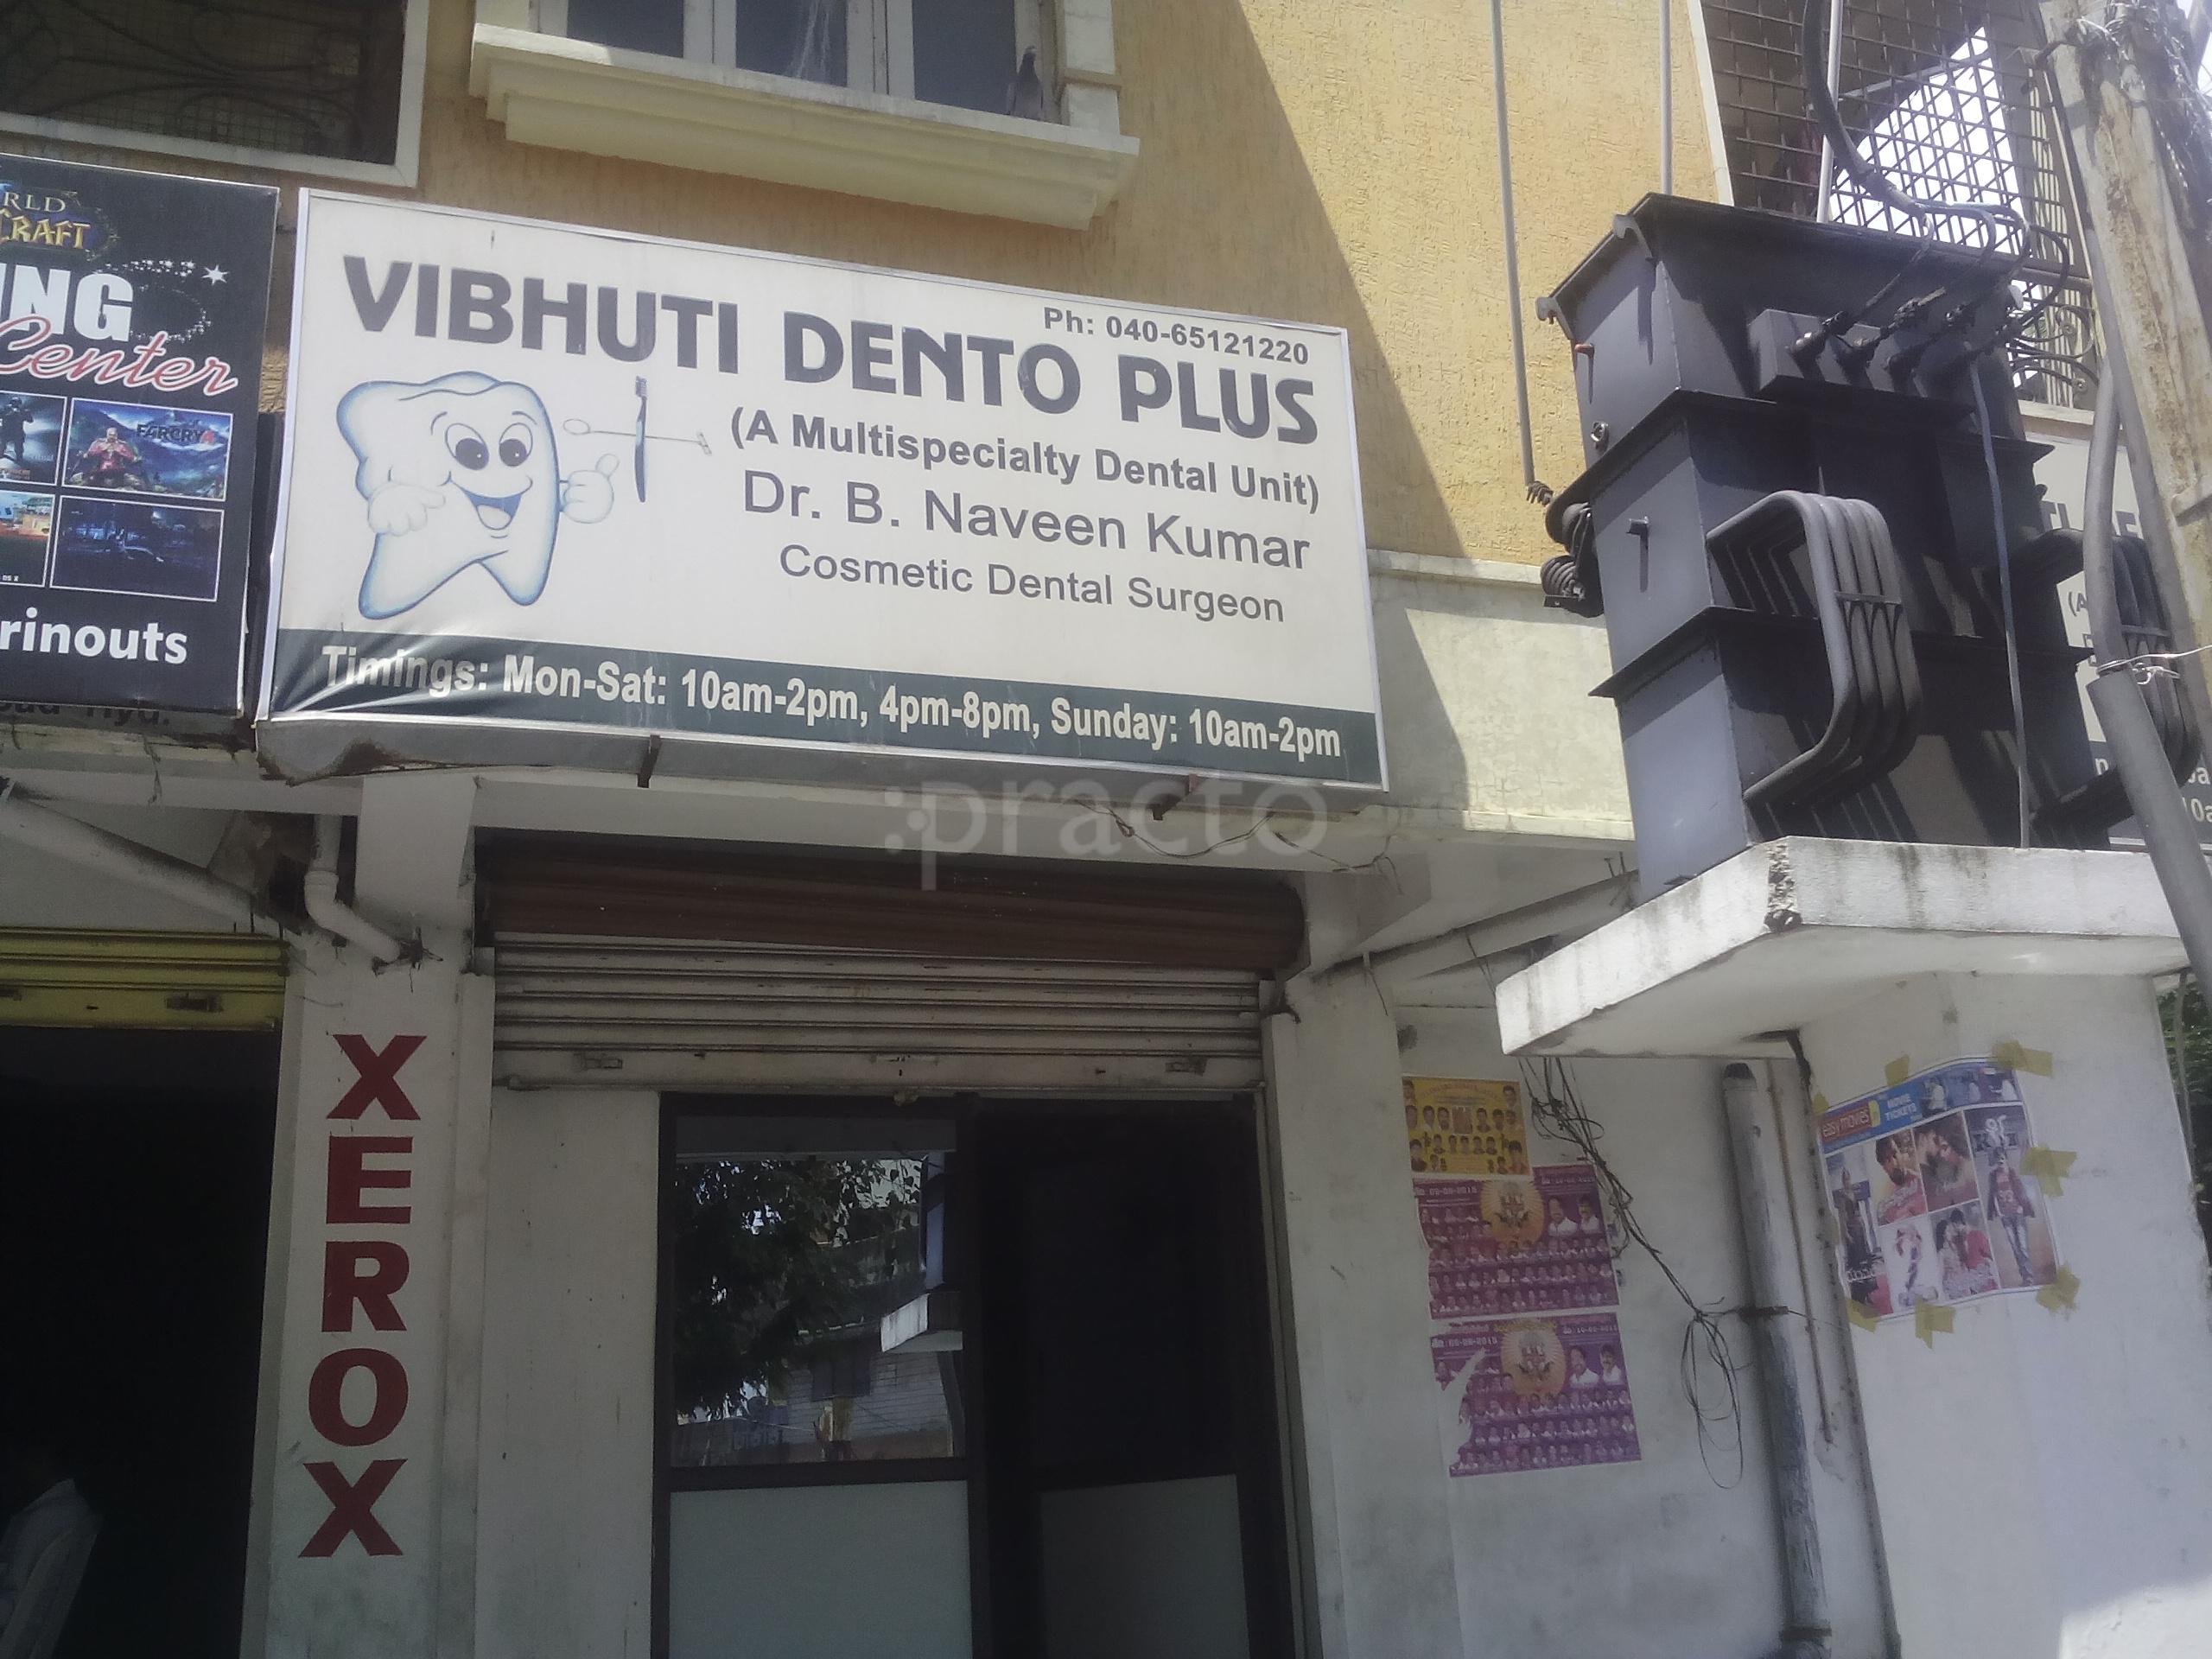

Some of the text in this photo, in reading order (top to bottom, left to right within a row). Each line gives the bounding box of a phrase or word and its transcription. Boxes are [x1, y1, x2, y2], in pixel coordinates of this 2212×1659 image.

[0, 314, 238, 396] Center
[343, 255, 1319, 445] VIBHUTI DENTO PLUS
[1044, 307, 1309, 365] Ph: 040-65121220
[731, 406, 1320, 514] (A Multispecialty Dental Unit)
[744, 470, 1311, 569] Dr. B. Naveen Kumar
[780, 543, 1284, 623] Cosmetic Dental Surgeon
[0, 607, 188, 664] rinouts
[321, 646, 1341, 762] Timings: Mon-Sat: 10am-2pm, 4pm-8pm, Sunday: 10am-2pm
[299, 1033, 428, 1558] XEROX
